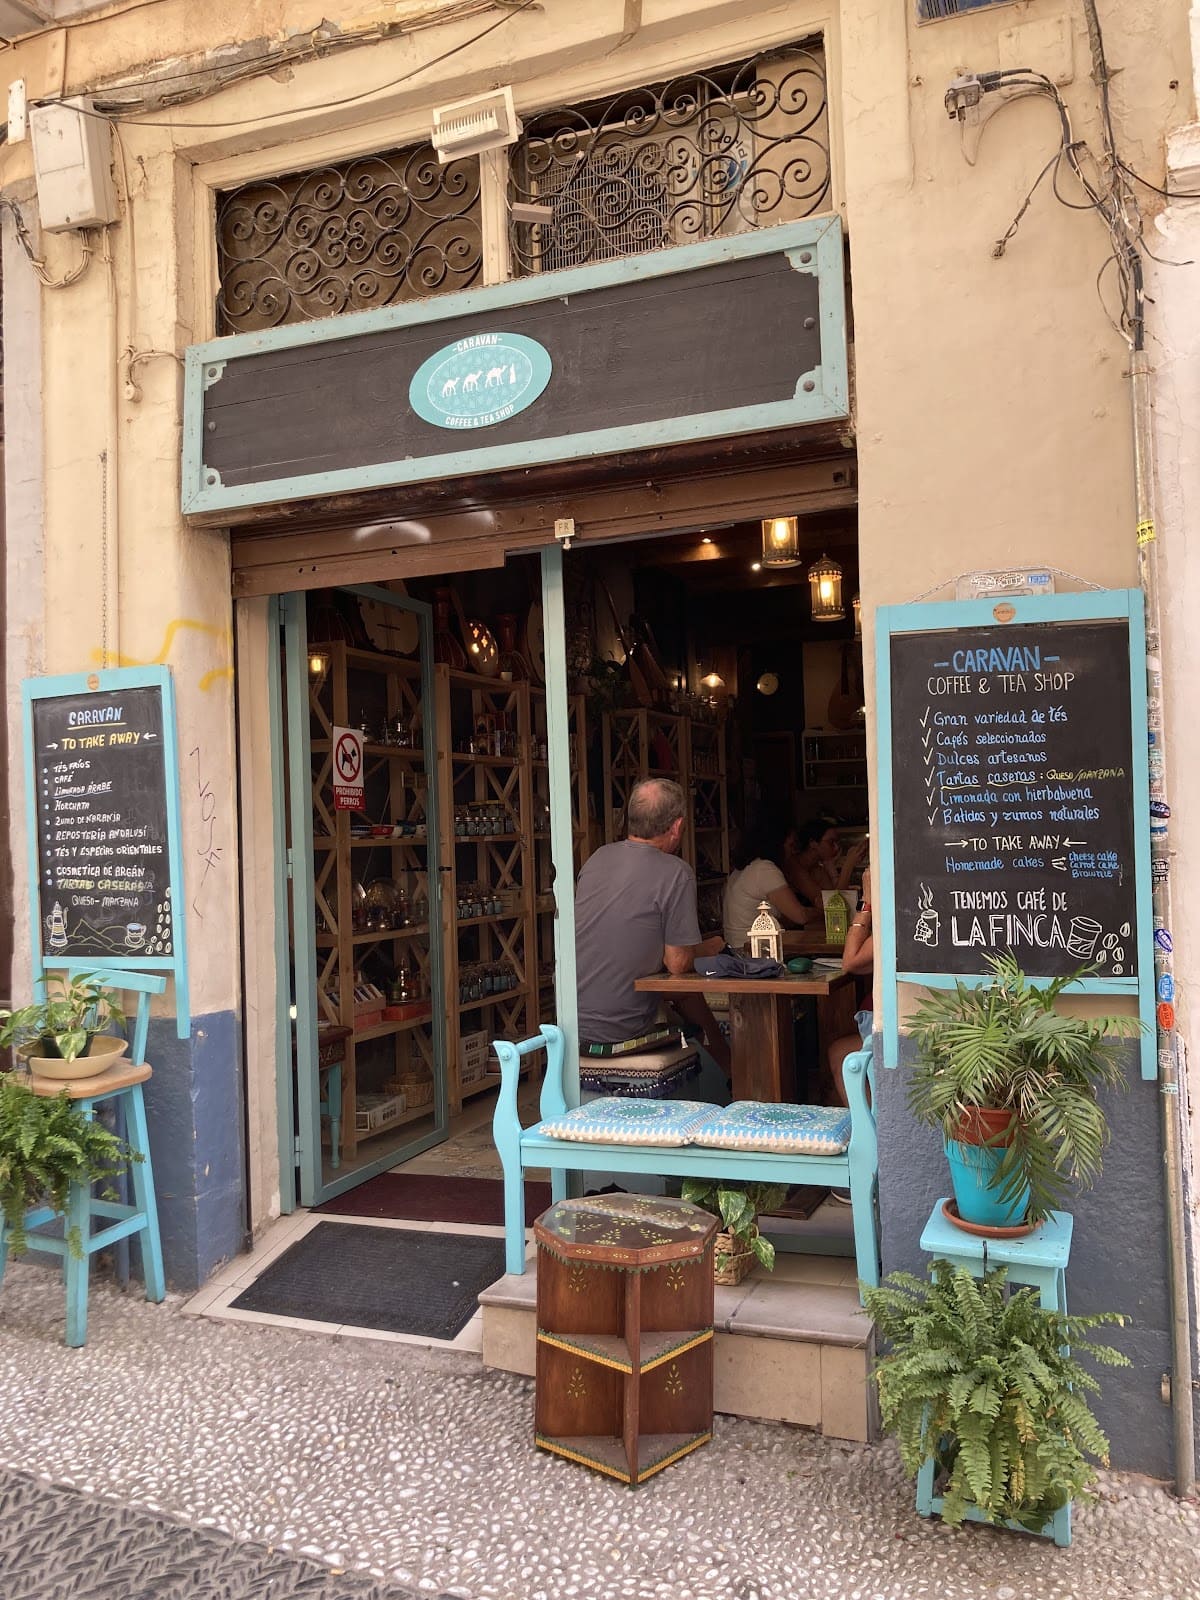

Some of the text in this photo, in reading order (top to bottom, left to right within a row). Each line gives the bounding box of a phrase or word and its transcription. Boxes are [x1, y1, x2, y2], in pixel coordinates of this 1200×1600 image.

[445, 404, 514, 427] COFFEE & TEA SHOP
[952, 646, 1041, 673] CARAVAN
[927, 671, 1075, 696] COFFEE & TEA SHOP
[69, 706, 123, 725] CARAVAN
[934, 704, 1068, 726] Gran variedad de tés
[62, 731, 140, 751] TO TAKE AWAY
[975, 730, 1047, 745] seleccionados
[936, 750, 1048, 766] Dulces artesanos
[937, 770, 979, 786] Tartas
[335, 786, 363, 796] PROHIBIDO
[340, 796, 360, 805] PERROS
[939, 785, 1094, 807] Limonada con hierbabuena
[942, 805, 1100, 827] Batidos y zumos naturales
[72, 846, 78, 857] Y
[969, 834, 1061, 852] TO TAKE AWAY
[103, 867, 113, 877] DE
[115, 864, 146, 878] ARGÁN
[945, 854, 1045, 873] Homemade cakes
[1071, 869, 1113, 879] Brownie
[950, 887, 1068, 911] TENEMOS CAFÉ DE
[951, 913, 1068, 949] LA FINCA
